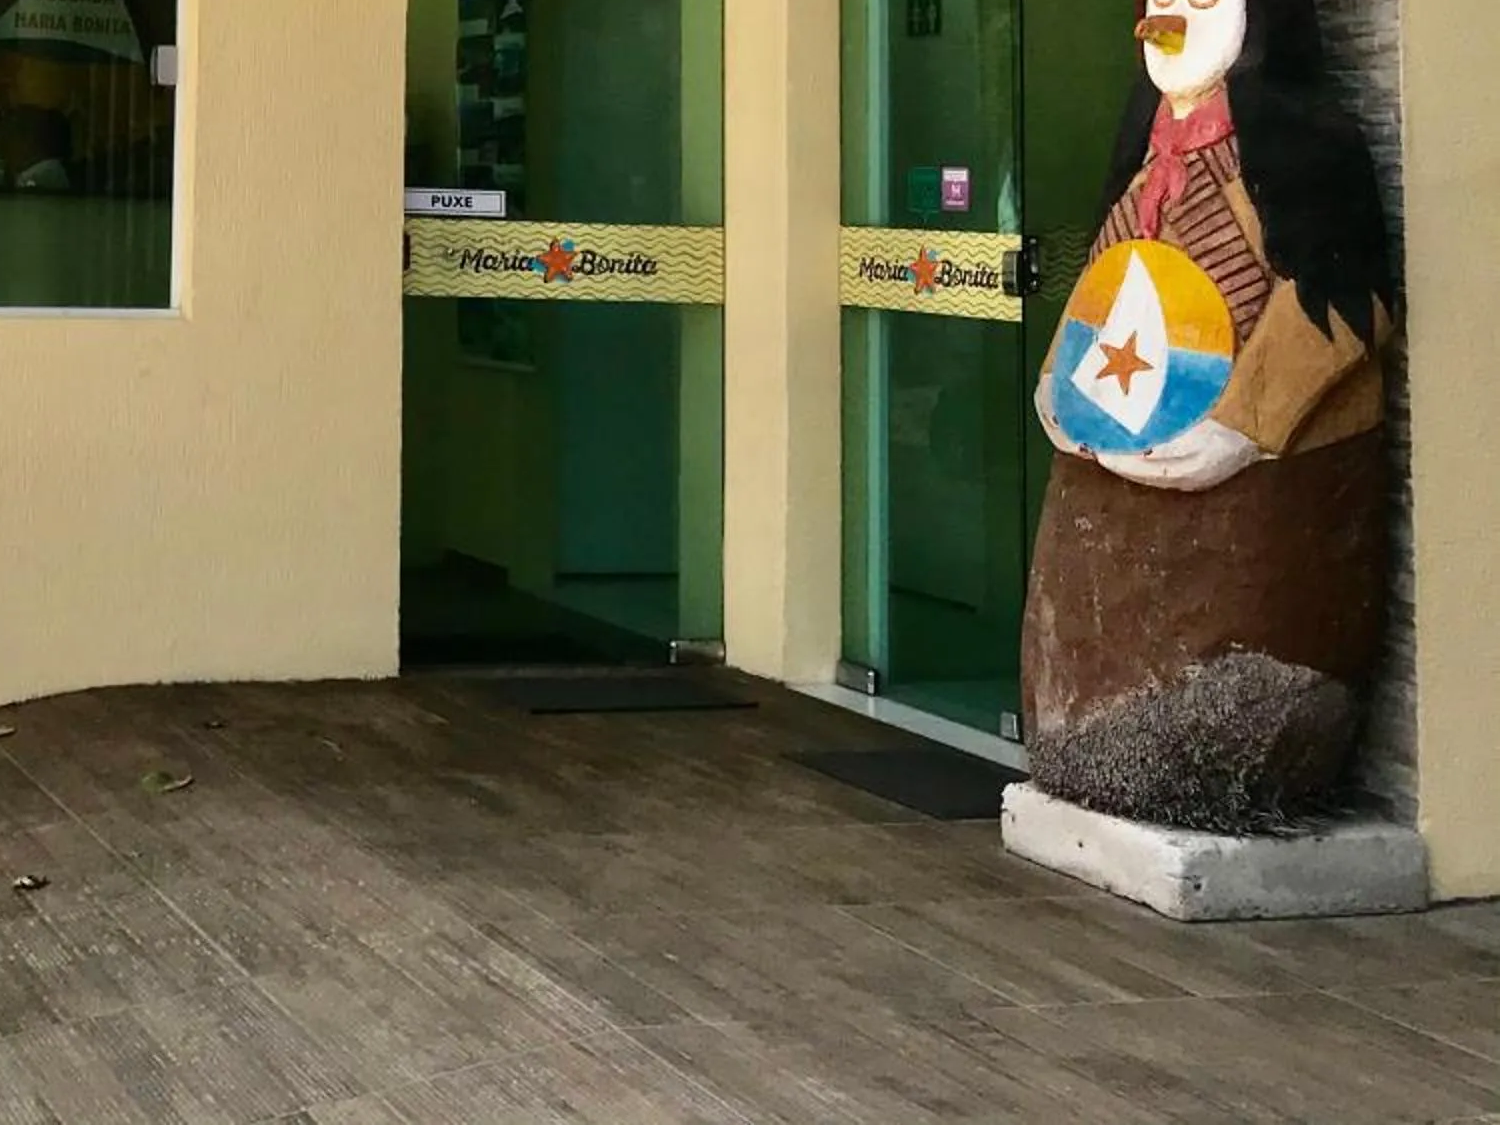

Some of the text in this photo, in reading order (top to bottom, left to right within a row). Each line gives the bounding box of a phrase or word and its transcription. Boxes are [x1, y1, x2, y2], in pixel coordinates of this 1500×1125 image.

[14, 11, 132, 35] MARIA BONITA
[431, 194, 474, 209] PUXE
[459, 248, 658, 276] Maria Bonita
[859, 256, 999, 289] Maria Bonita
